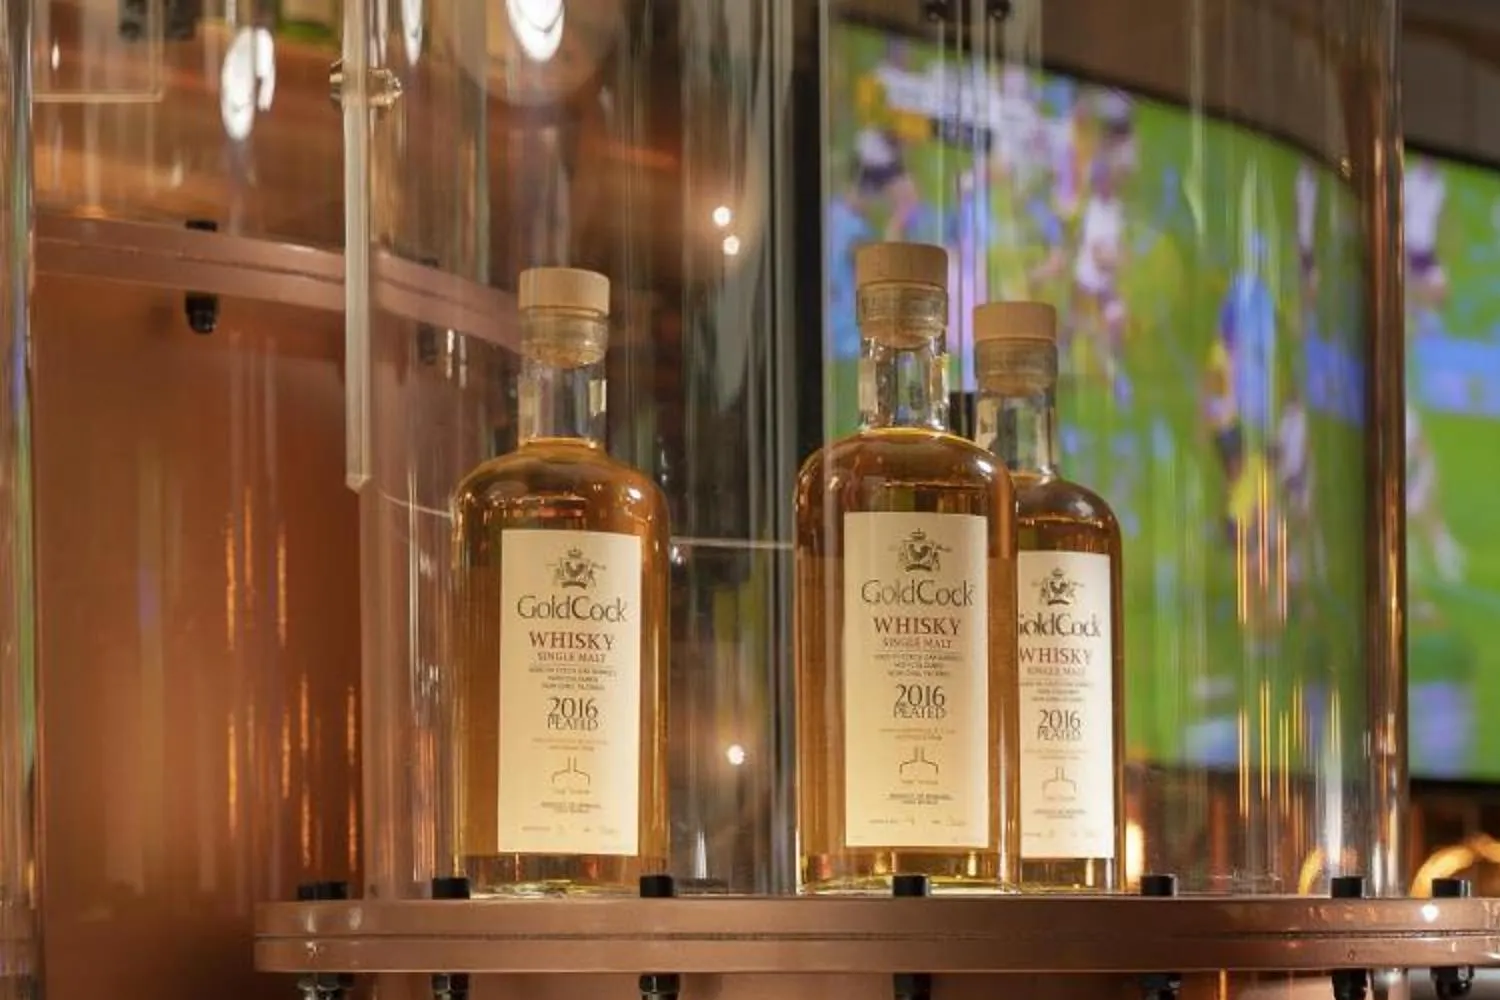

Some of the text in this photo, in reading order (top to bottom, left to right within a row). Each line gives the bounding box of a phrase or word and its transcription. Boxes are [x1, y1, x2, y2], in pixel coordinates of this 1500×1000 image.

[861, 579, 973, 607] GoldCock
[517, 594, 627, 622] GoldCock
[873, 617, 961, 636] WHISKY
[528, 631, 615, 650] WHISKY
[924, 639, 952, 649] MALT
[537, 652, 606, 663] SINGLE MALT
[1019, 647, 1093, 665] WHISKY
[895, 683, 945, 706] 2016
[548, 697, 598, 719] 2016
[893, 702, 946, 719] PEATED
[1039, 709, 1081, 729] 2016
